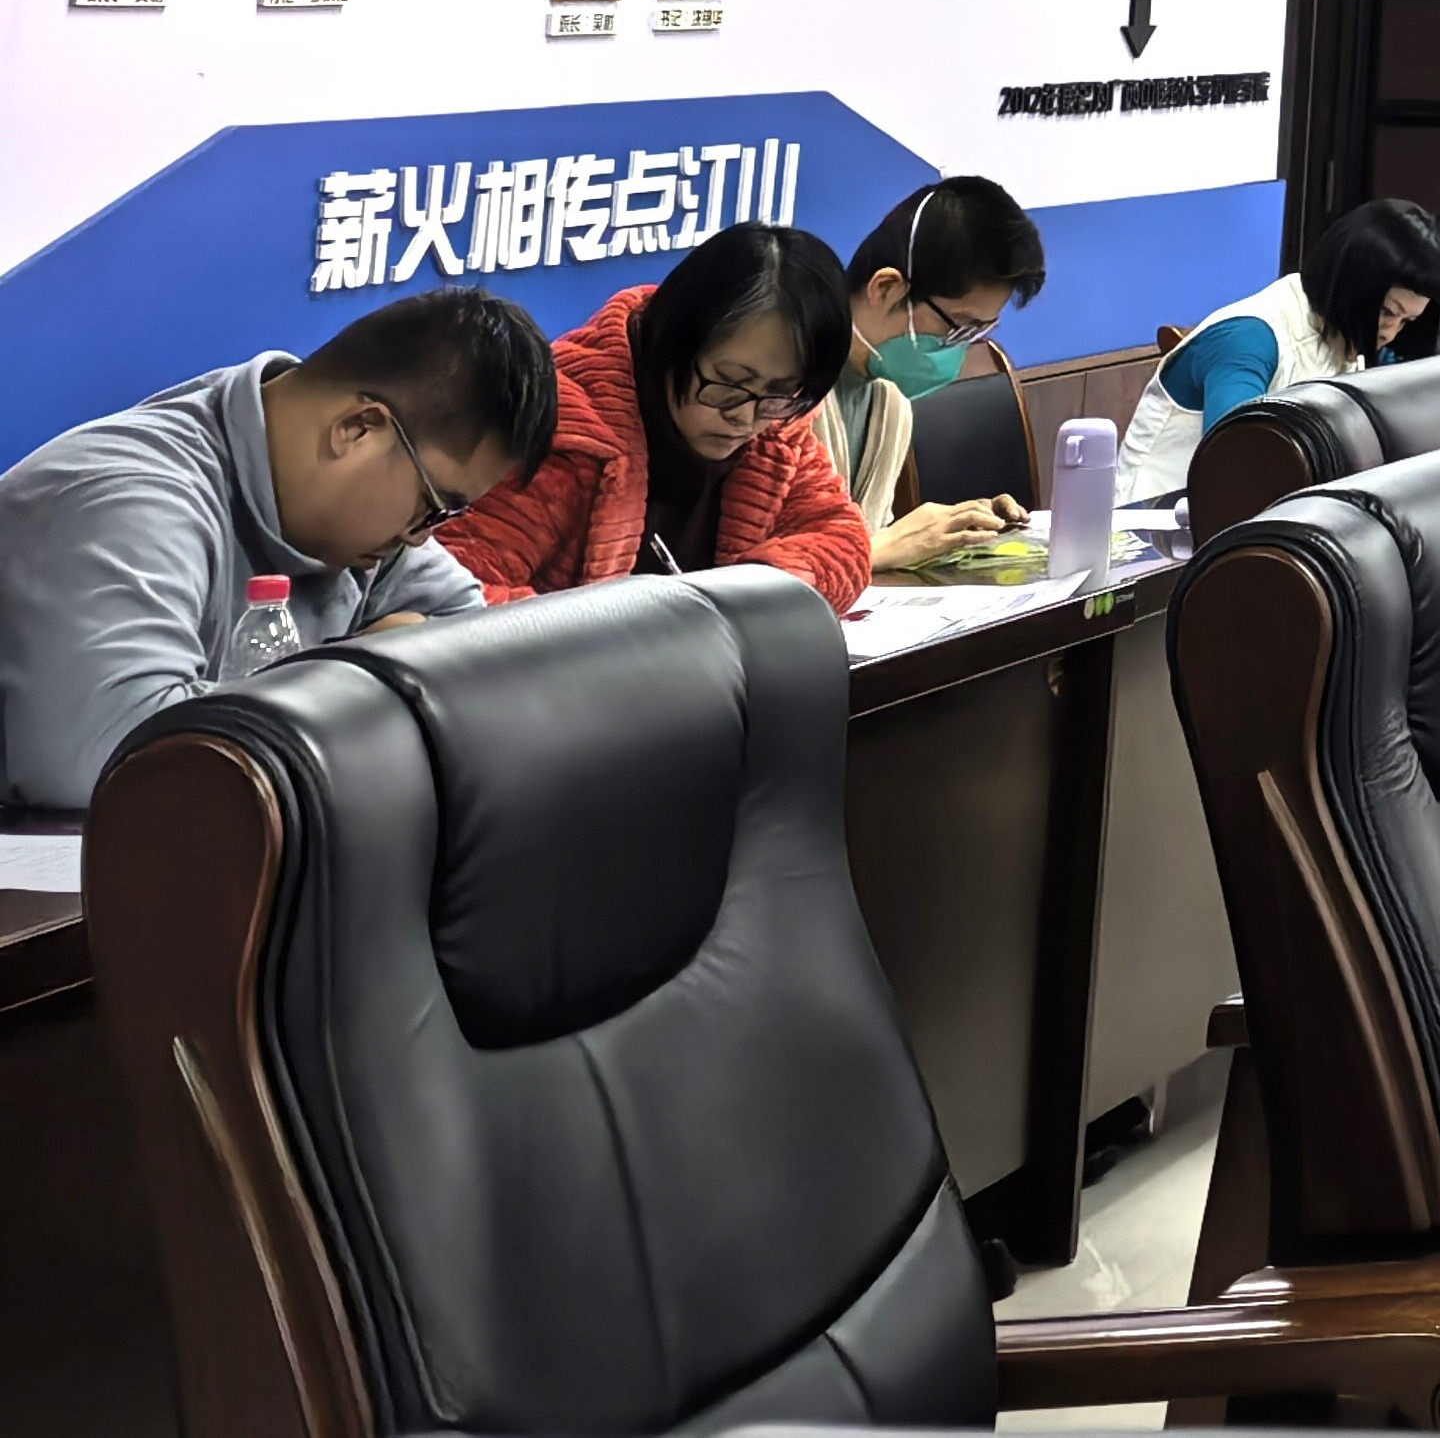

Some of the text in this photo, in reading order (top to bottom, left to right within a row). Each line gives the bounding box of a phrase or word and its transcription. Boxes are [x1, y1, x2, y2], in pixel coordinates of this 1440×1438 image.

[310, 138, 801, 293] 薪火相传点江山
